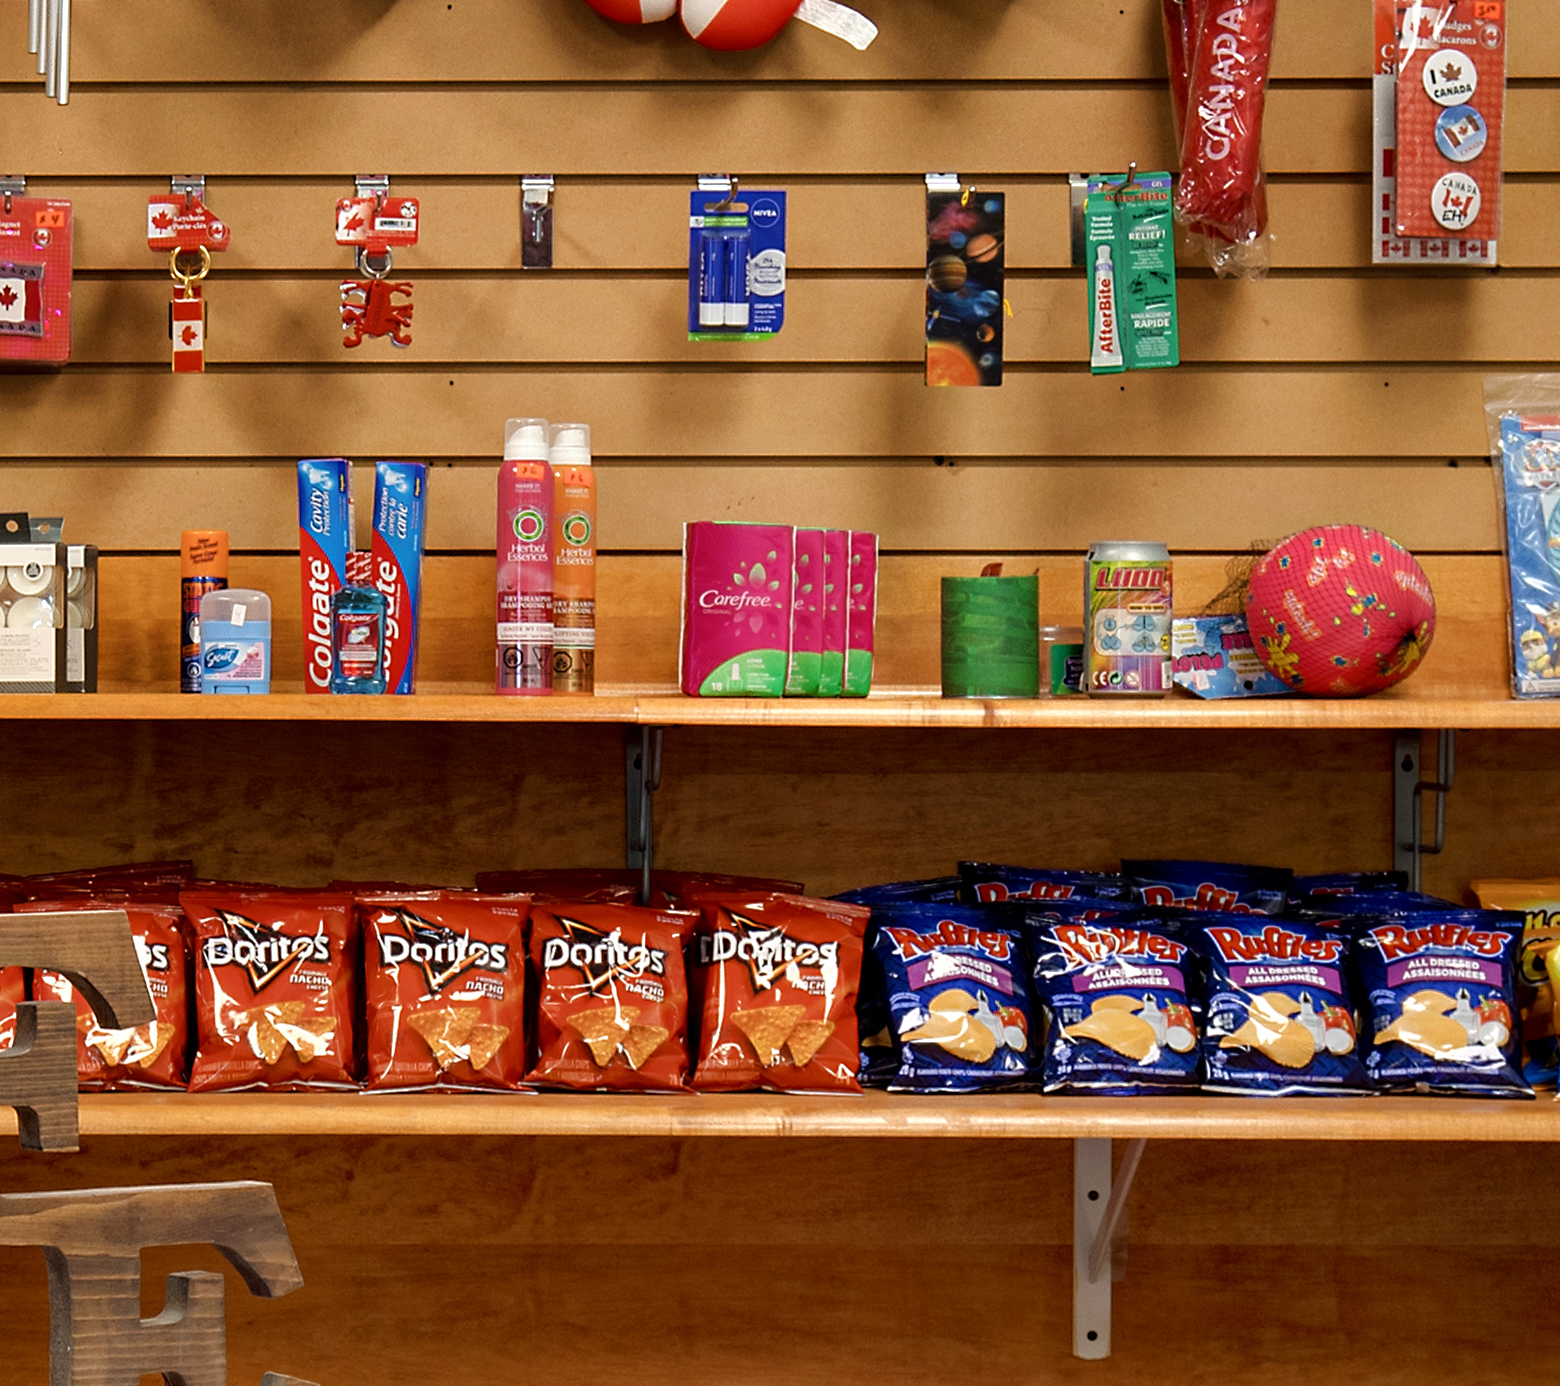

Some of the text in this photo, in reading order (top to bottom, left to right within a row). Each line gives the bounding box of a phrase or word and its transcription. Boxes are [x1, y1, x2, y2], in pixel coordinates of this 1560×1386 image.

[1205, 7, 1245, 160] CANADA
[1433, 83, 1473, 99] CANADA
[1441, 178, 1477, 196] CANADA
[1129, 229, 1166, 240] RELIEF!
[1098, 278, 1113, 354] AfterBite
[1134, 318, 1170, 329] RAPIDE
[310, 488, 324, 533] Cavity
[323, 490, 331, 536] Protection
[379, 487, 388, 531] Protection
[388, 510, 396, 536] contre
[397, 503, 408, 539] carie
[507, 552, 549, 562] Essences
[511, 543, 546, 553] Herbal
[561, 548, 592, 557] Herbal
[699, 589, 771, 611] Carefree
[308, 558, 330, 688] Colgate
[339, 614, 371, 623] Colgate
[205, 648, 234, 667] Secret
[711, 682, 723, 691] 18
[206, 935, 329, 966] Doritos
[711, 931, 839, 967] Doritos
[883, 919, 1014, 963] Ruffles
[1207, 926, 1345, 964] Ruffles
[1371, 923, 1513, 964] Ruffles
[382, 934, 507, 969] Doritos
[543, 937, 665, 973] Doritos
[1248, 966, 1319, 977] ALL DRESSED
[1402, 967, 1486, 981] ASSAISONNÉES
[1408, 959, 1429, 970] ALL
[289, 974, 331, 986] NACHO
[465, 980, 505, 995] NACHO
[1245, 973, 1327, 986] ASSAISONNÉES
[625, 983, 665, 998] NACHO
